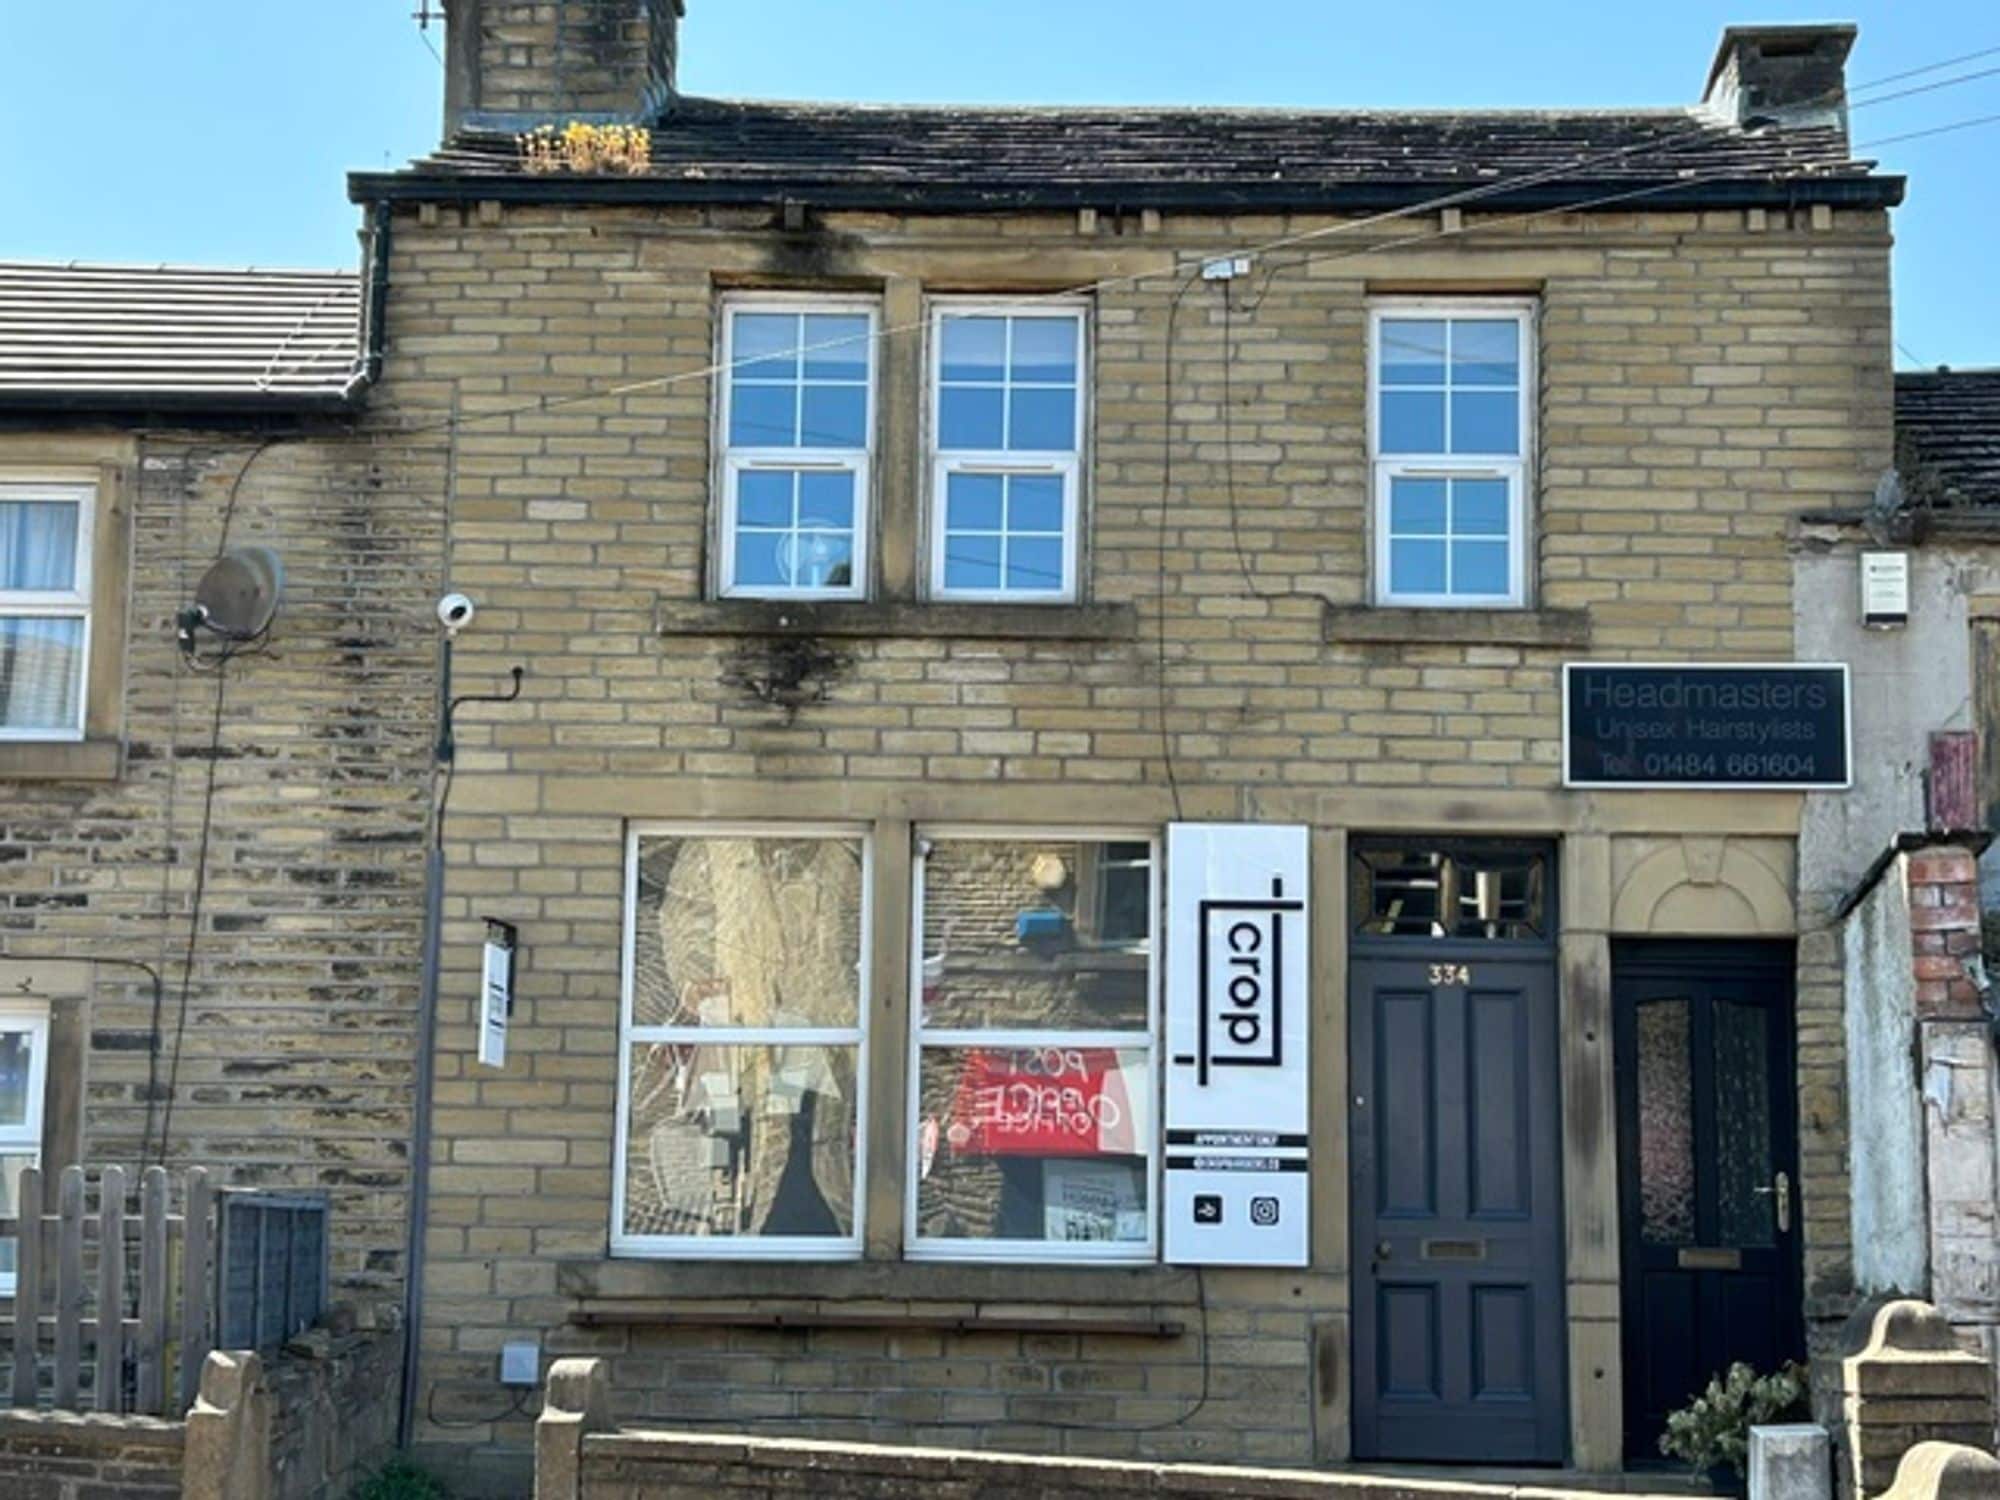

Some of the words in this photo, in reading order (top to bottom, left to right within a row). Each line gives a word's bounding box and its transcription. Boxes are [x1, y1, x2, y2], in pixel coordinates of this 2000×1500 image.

[1584, 675, 1827, 709] Headmasters
[1644, 753, 1717, 777] 01484
[1727, 753, 1815, 777] 661604
[1219, 921, 1262, 1045] crop
[1429, 963, 1470, 986] 334
